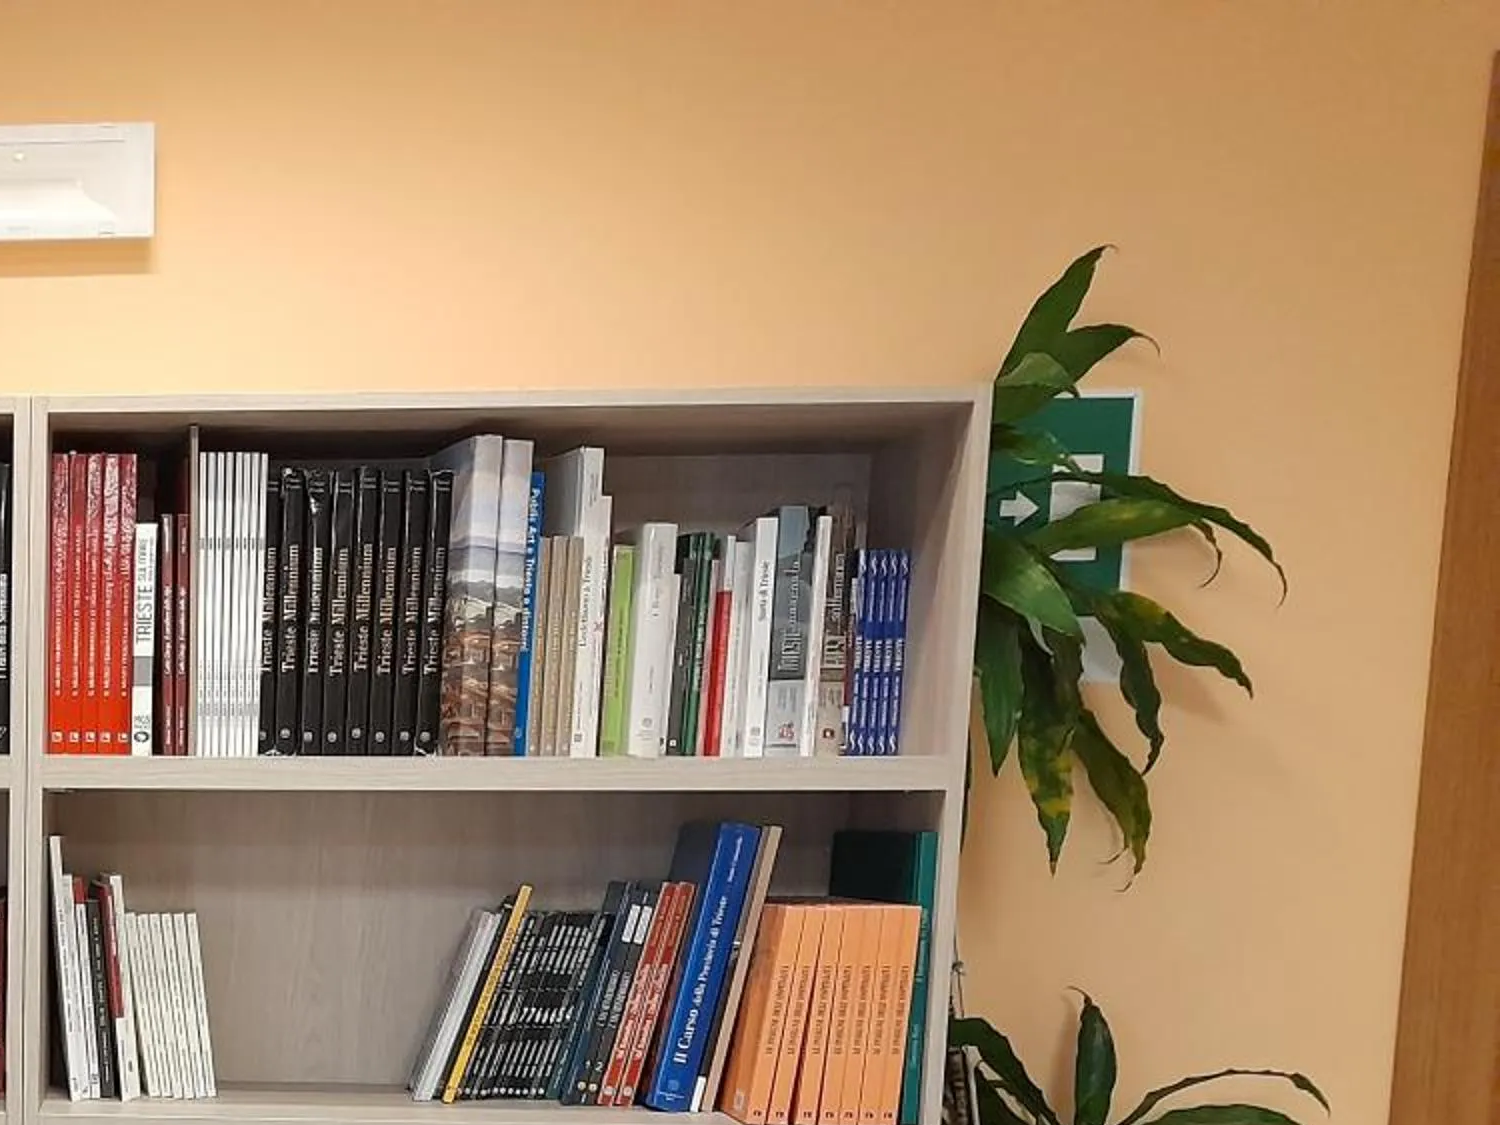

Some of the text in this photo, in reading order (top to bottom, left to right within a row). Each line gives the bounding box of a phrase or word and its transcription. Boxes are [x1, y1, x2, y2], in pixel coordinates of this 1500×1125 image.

[523, 557, 535, 595] Trieste
[526, 525, 537, 545] Art
[136, 586, 153, 643] TRIESTE
[260, 547, 277, 673] Trieste Millennium
[282, 544, 299, 672] Trieste Millennium
[308, 628, 319, 673] Trieste
[330, 548, 348, 676] Trieste Millennium
[354, 544, 373, 671] Trieste Millennium
[377, 547, 396, 674] Trieste Millennium
[402, 547, 420, 674] Trieste Millennium
[424, 547, 445, 674] Trieste Millennium
[677, 1008, 700, 1049] Carso
